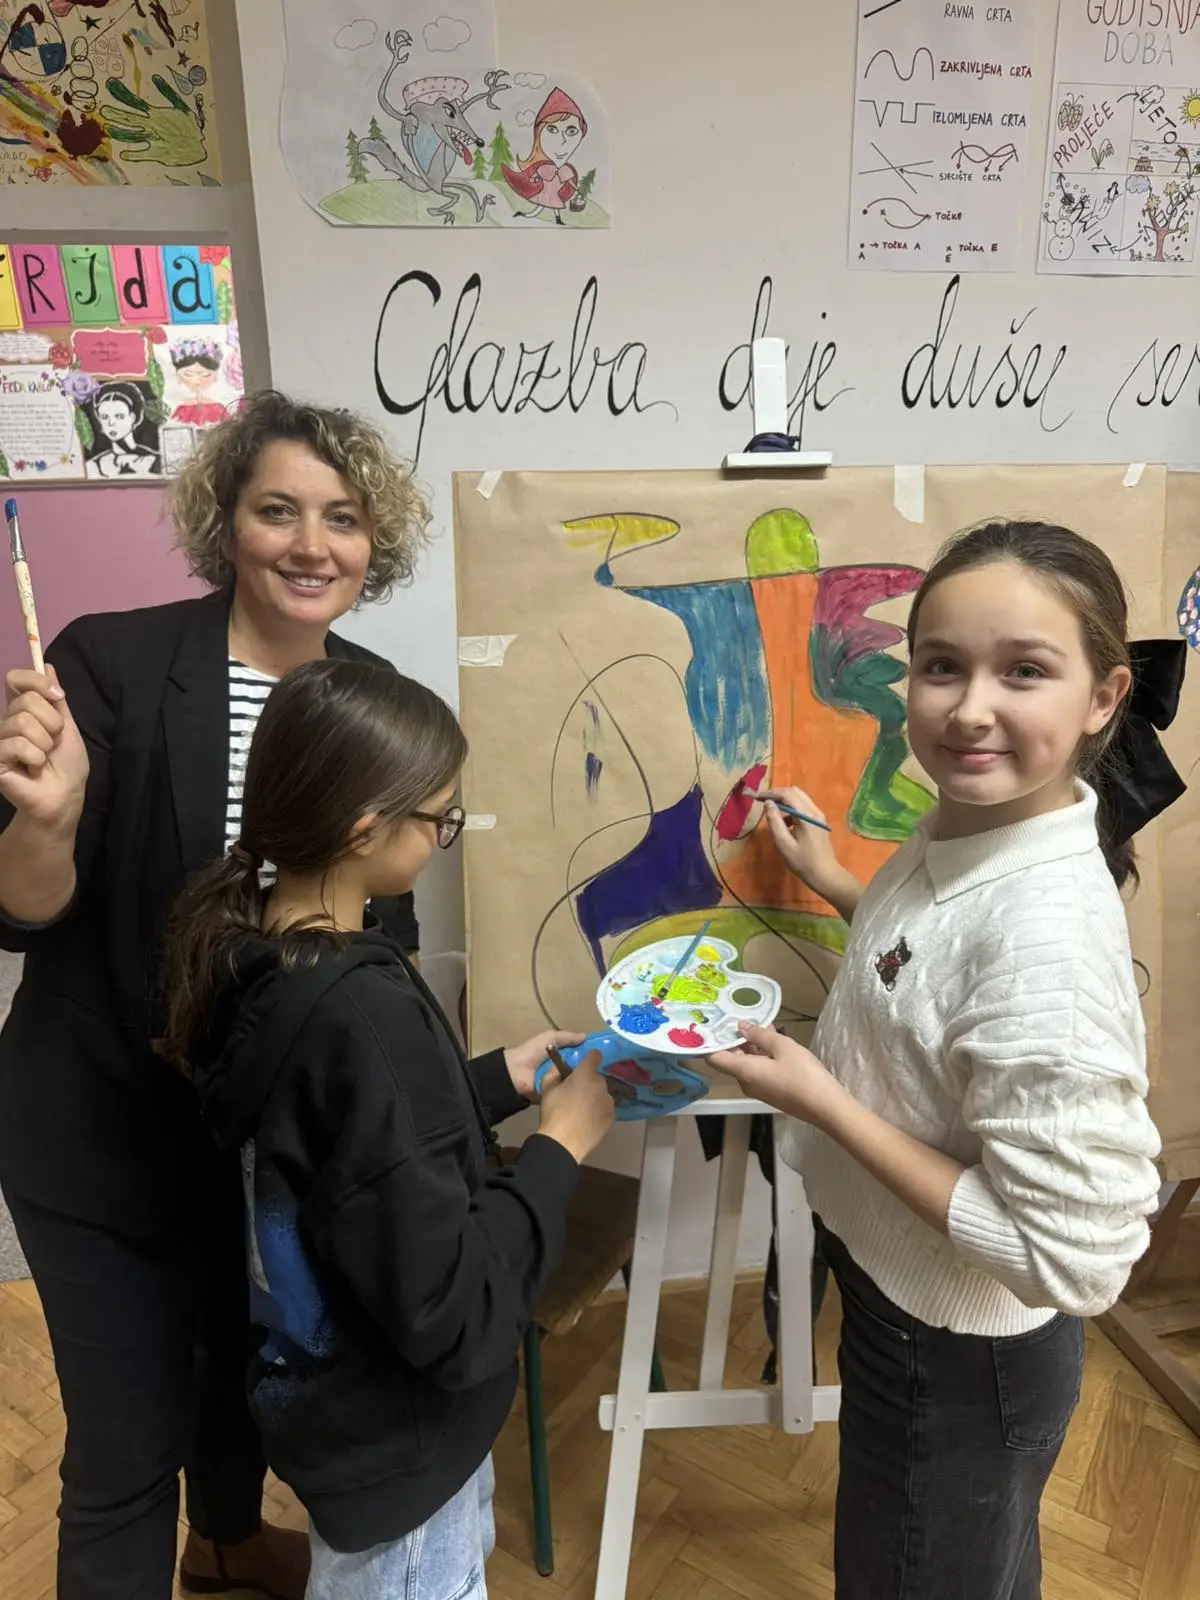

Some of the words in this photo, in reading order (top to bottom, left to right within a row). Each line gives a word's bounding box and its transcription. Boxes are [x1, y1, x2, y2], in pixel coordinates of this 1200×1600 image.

[944, 2, 975, 20] RAVNA
[986, 7, 1012, 22] CRTA
[1104, 30, 1173, 66] DOBA
[940, 60, 1002, 80] ZAKRIVLJENA
[1010, 65, 1032, 78] CRTA
[933, 110, 993, 131] IZLOMLJENA
[1001, 113, 1027, 127] CRTA
[1139, 90, 1178, 144] LJETO
[1053, 101, 1114, 168] PROLJEĆE
[982, 174, 1002, 182] CRTA
[935, 211, 962, 221] TOČKE
[859, 251, 866, 260] A
[882, 241, 908, 250] TOČKA
[914, 242, 921, 250] A
[374, 270, 679, 477] Glazba
[719, 276, 856, 452] dje
